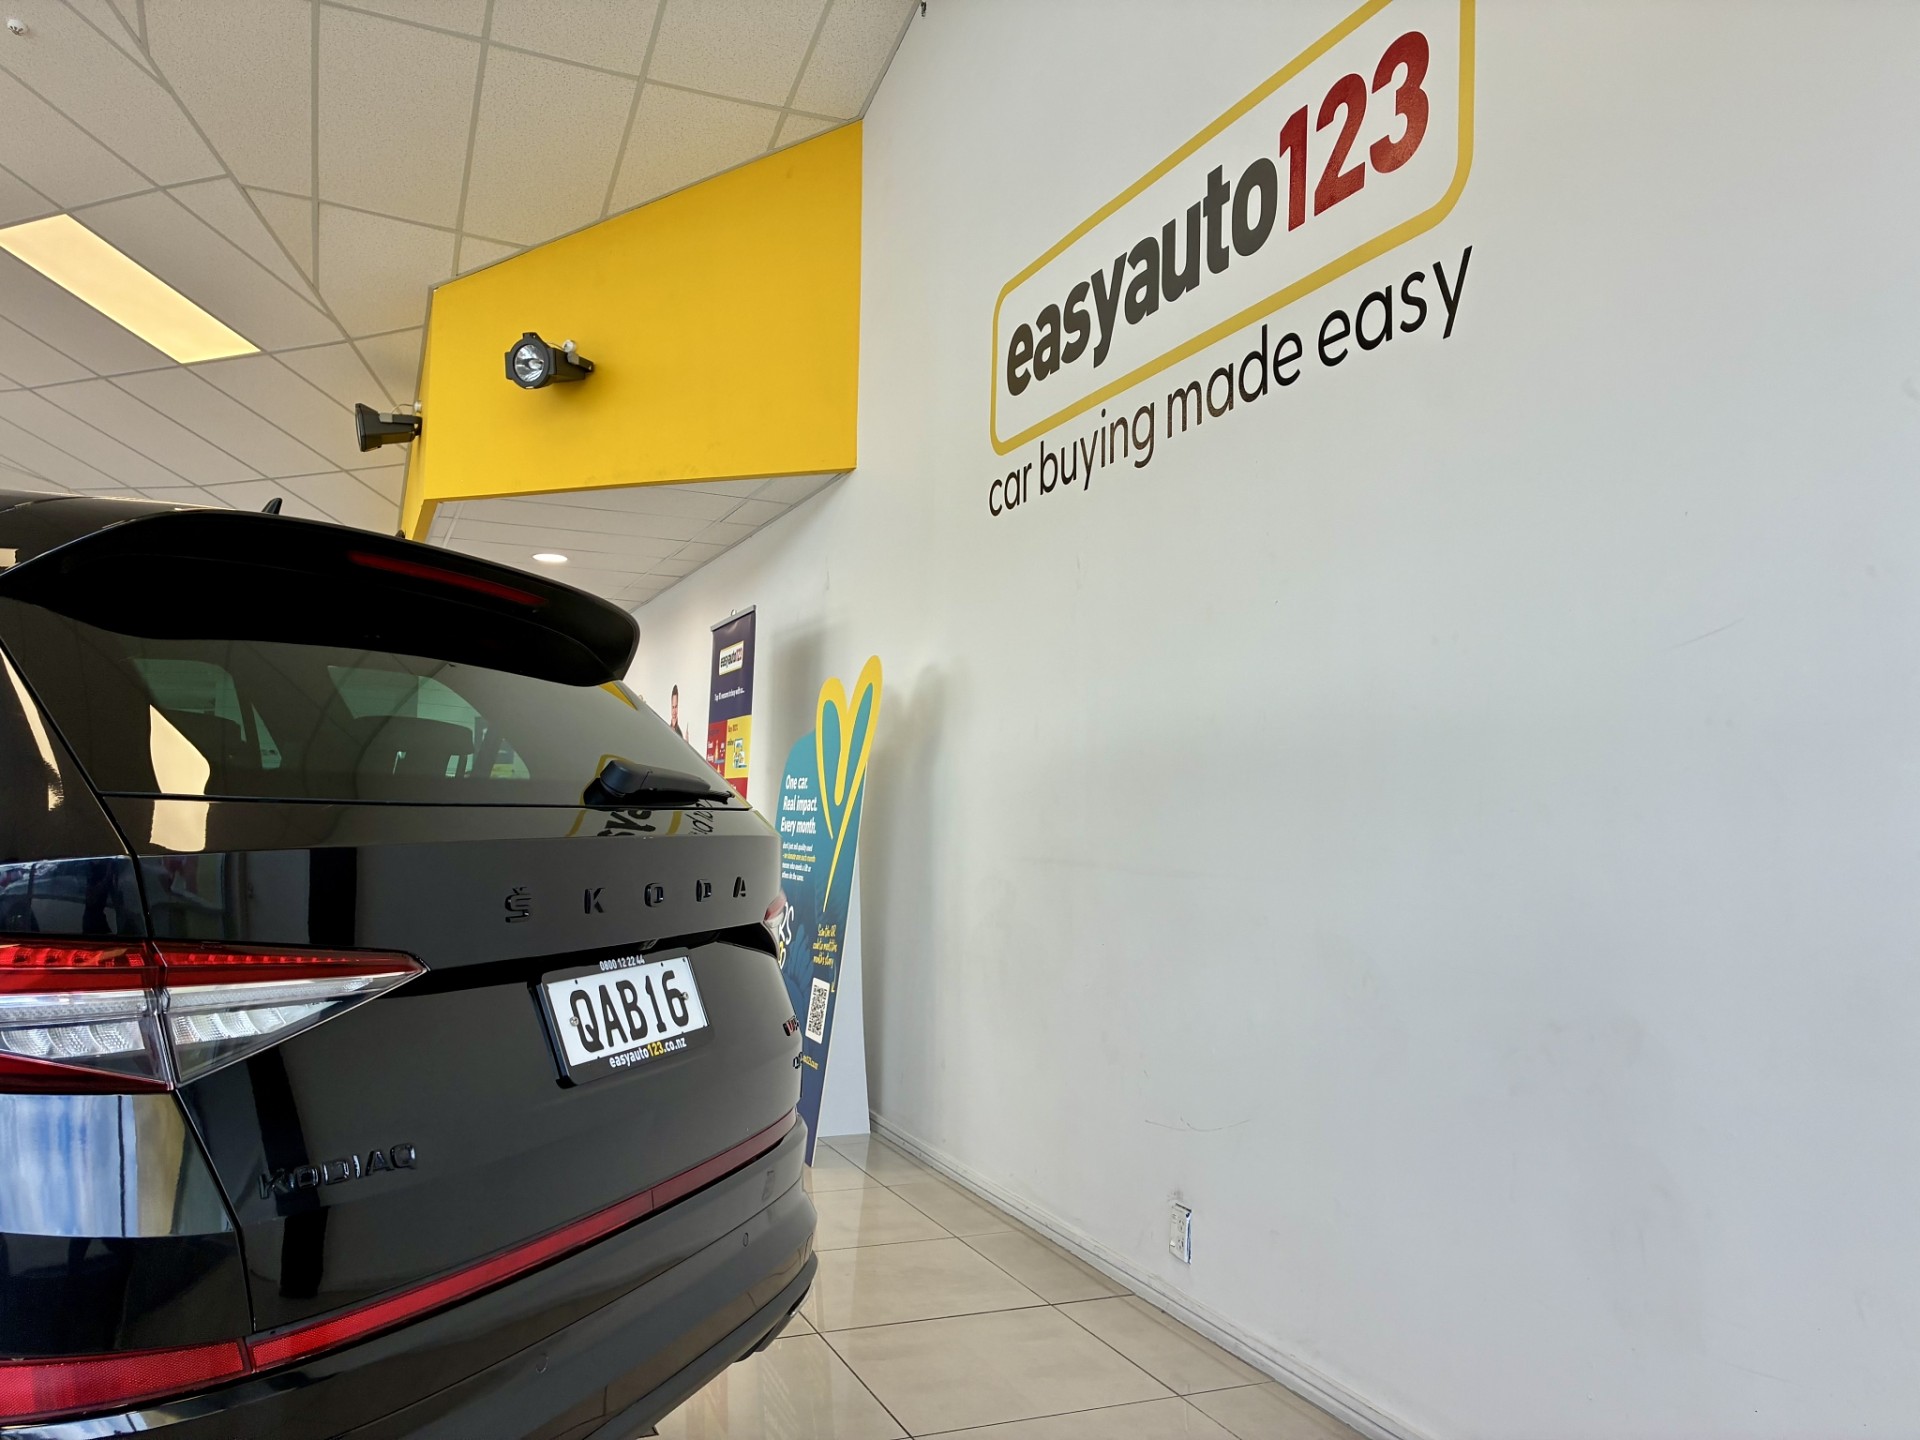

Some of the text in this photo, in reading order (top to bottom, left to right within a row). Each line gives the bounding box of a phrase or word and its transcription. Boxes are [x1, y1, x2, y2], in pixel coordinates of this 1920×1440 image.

[1006, 30, 1430, 396] easyauto123
[989, 245, 1472, 517] car buying made easy
[785, 774, 797, 790] One
[783, 795, 796, 811] Real
[780, 816, 796, 836] Every
[504, 876, 747, 923] ŠKODA
[599, 954, 645, 971] 0800 12 22 44
[569, 970, 690, 1053] QAB16
[609, 1037, 687, 1068] easyauto123.co.nz
[258, 1142, 417, 1199] KODIAQ
